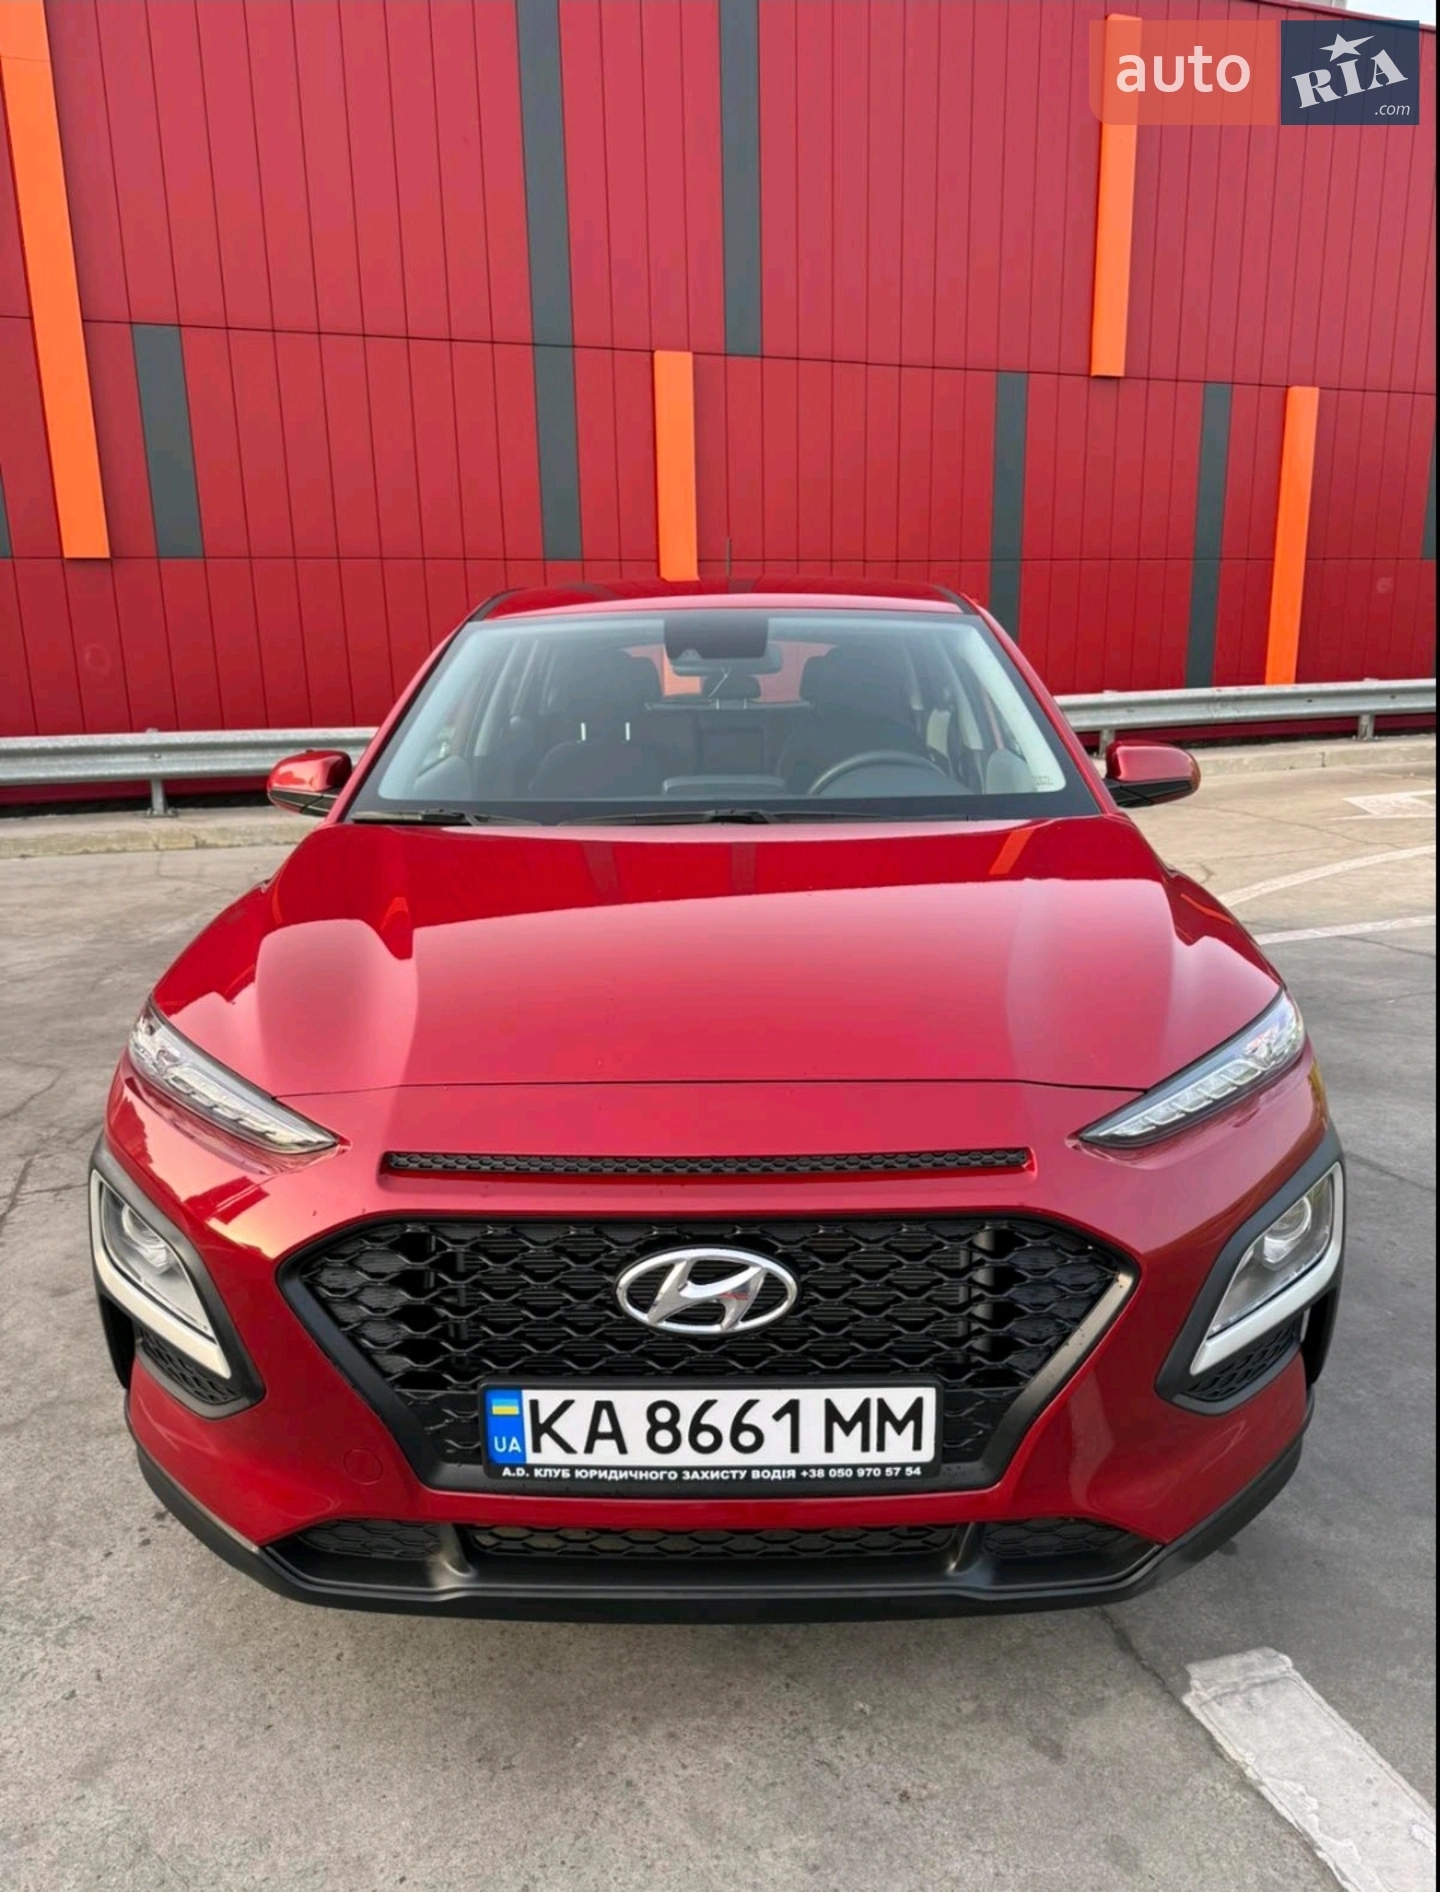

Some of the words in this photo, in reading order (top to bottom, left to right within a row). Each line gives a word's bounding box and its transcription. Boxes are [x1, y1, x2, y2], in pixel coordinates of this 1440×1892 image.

[529, 1398, 629, 1455] KA
[645, 1399, 801, 1455] 8661
[823, 1396, 925, 1454] MM
[493, 1435, 521, 1454] UA
[534, 1468, 571, 1479] КЛУБ
[574, 1468, 678, 1482] ЮРИДИЧНОГО
[682, 1469, 747, 1481] ЗАХИСТУ
[751, 1469, 796, 1481] ВОДІЯ
[800, 1468, 825, 1479] +38
[828, 1468, 853, 1478] 050
[857, 1467, 881, 1478] 970
[885, 1467, 901, 1477] 57
[905, 1466, 921, 1476] 54
